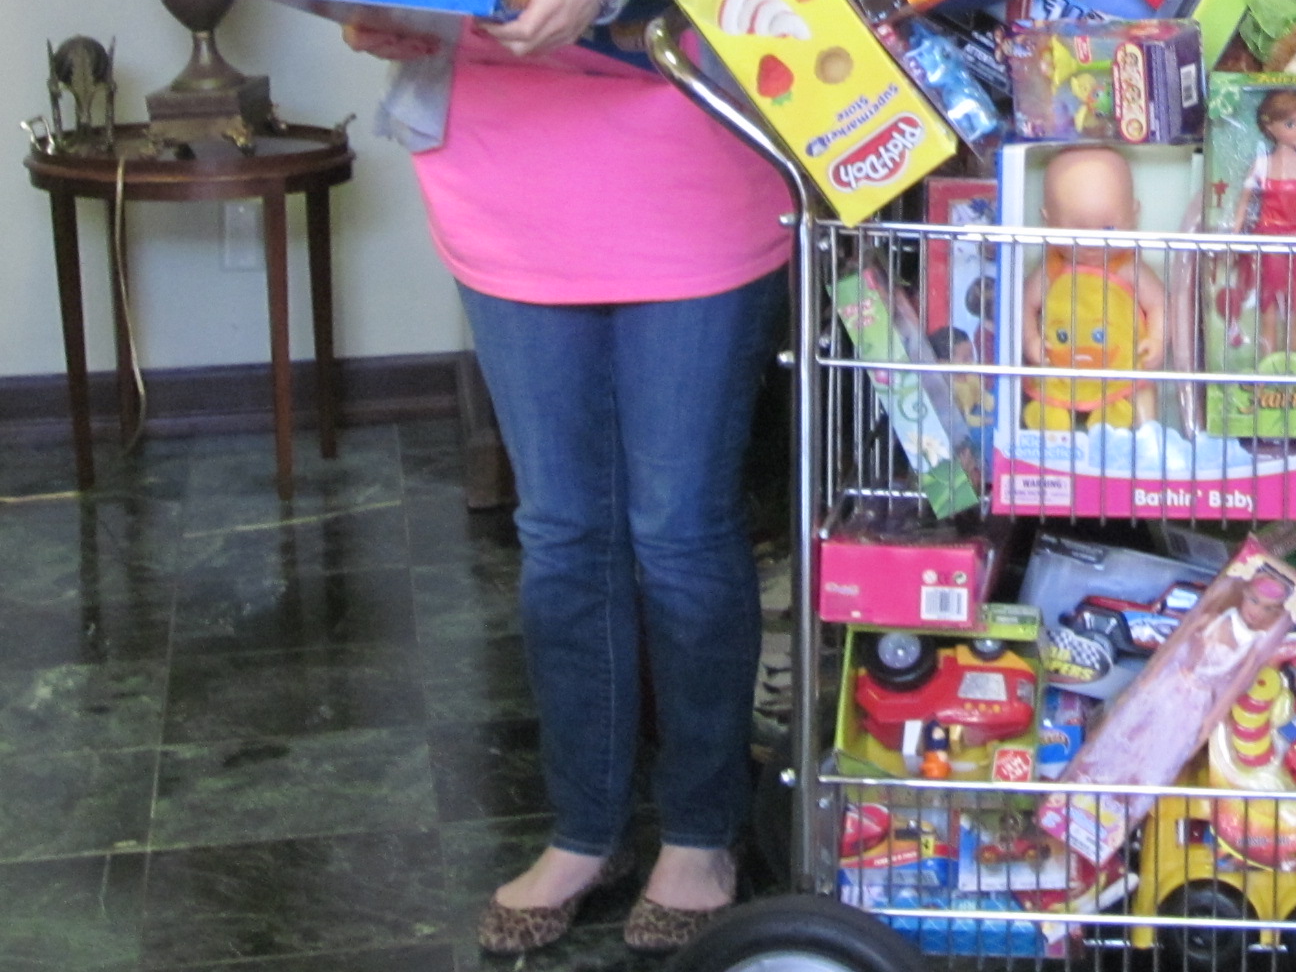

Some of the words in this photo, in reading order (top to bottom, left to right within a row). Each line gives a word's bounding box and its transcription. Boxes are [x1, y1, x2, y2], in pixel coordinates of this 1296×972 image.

[836, 95, 870, 122] Store
[839, 121, 924, 190] Play-Doh
[1134, 488, 1203, 508] Bahin'
[1208, 488, 1254, 513] Baby
